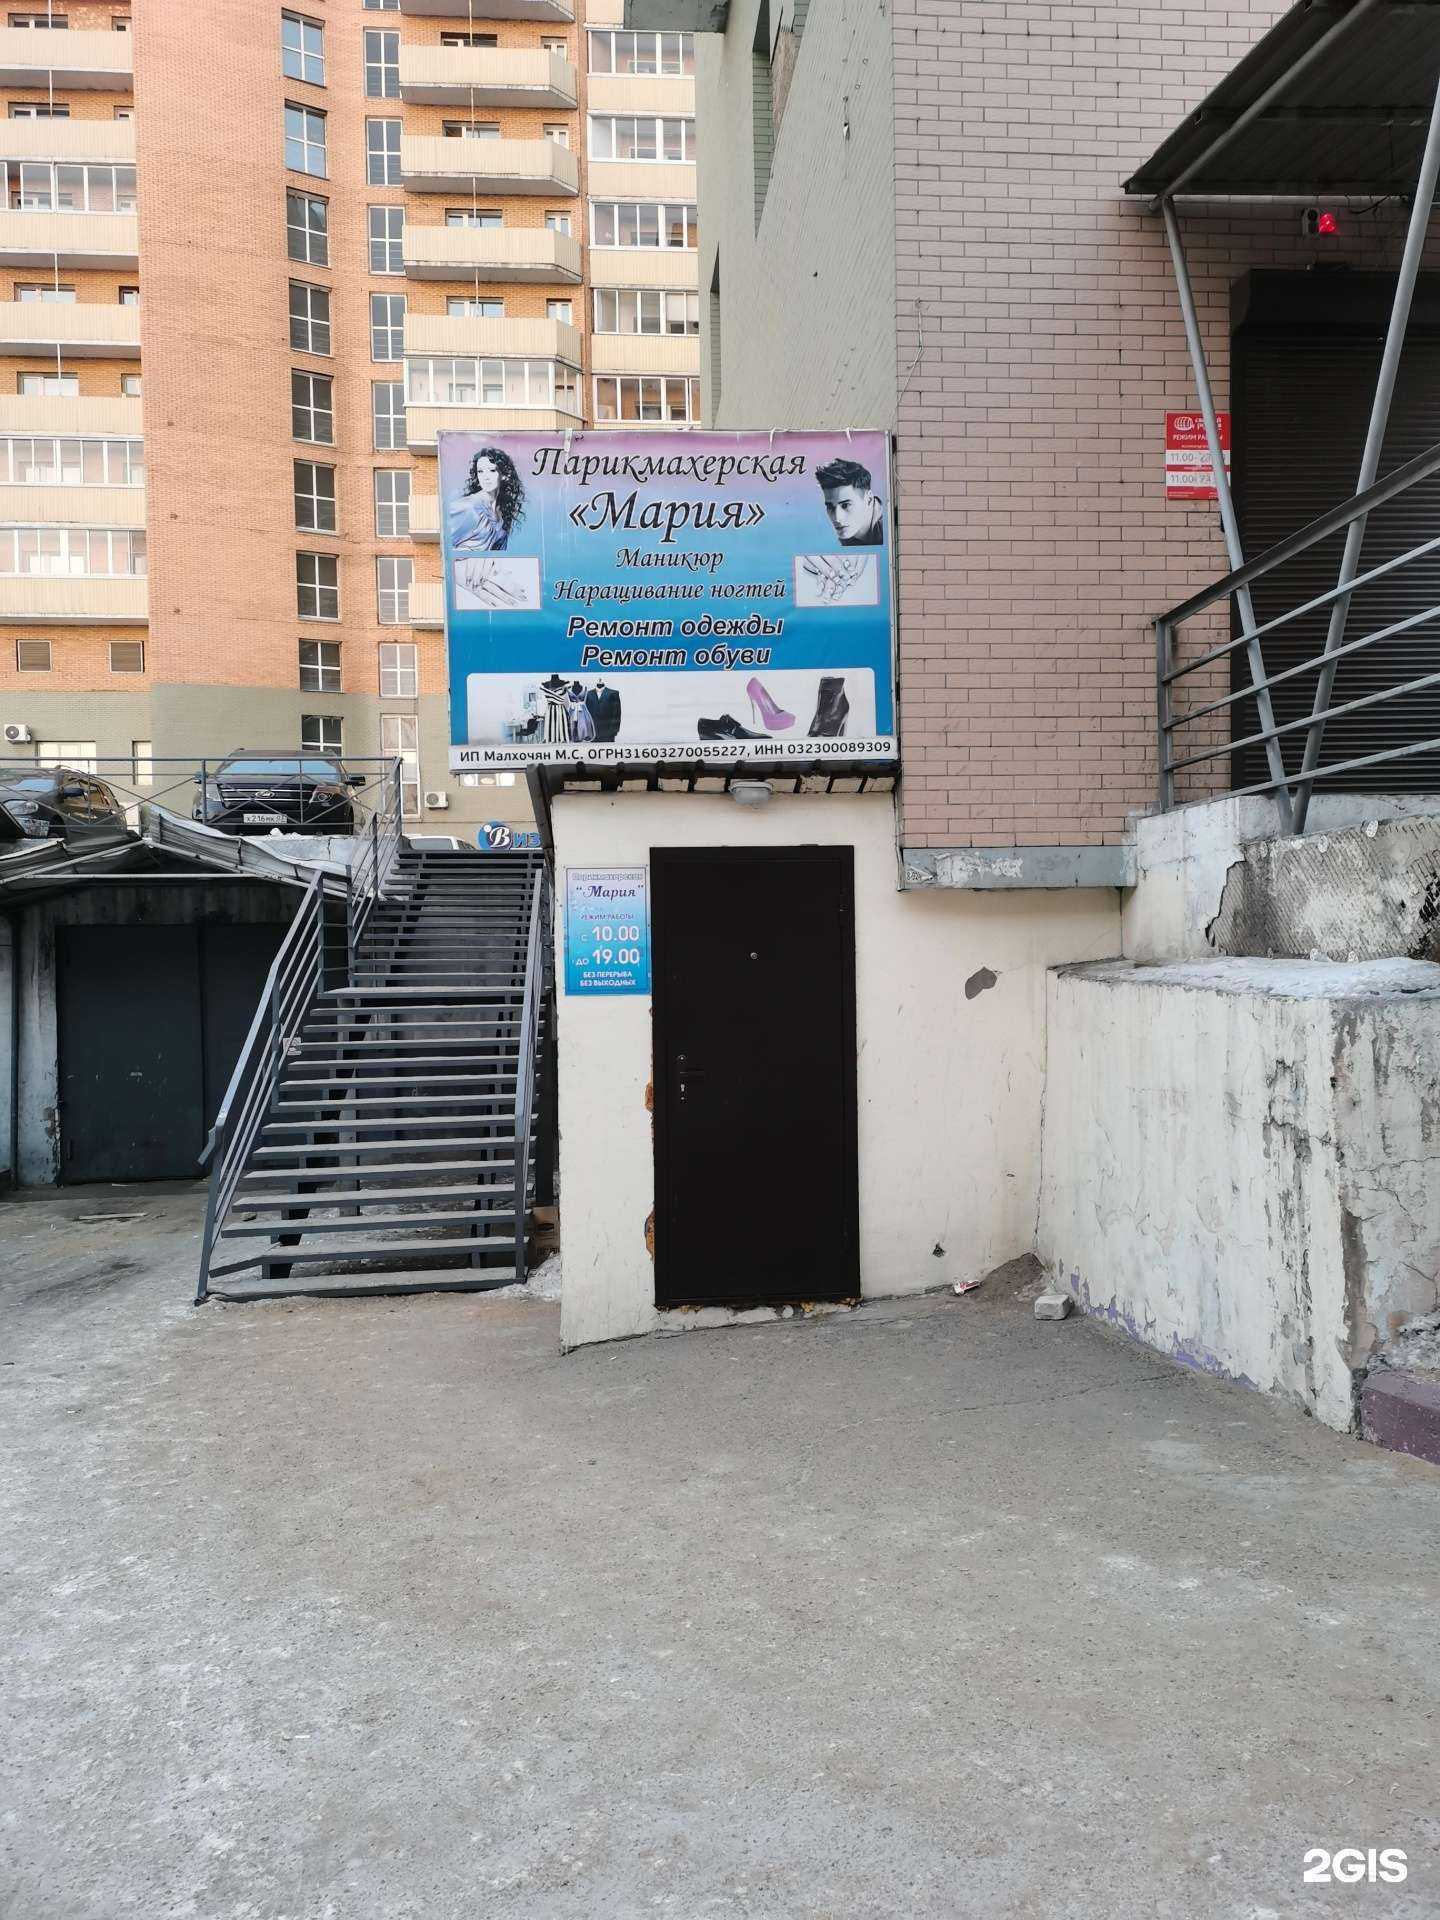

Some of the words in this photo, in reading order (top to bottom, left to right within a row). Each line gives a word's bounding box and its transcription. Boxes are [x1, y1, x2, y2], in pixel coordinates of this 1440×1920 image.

[531, 447, 807, 486] Парикмахерская
[569, 489, 766, 544] «Мария»
[616, 547, 725, 573] Маникюр
[553, 579, 704, 607] Наращивание
[710, 579, 786, 599] ногтей
[567, 615, 673, 638] Ремонт
[681, 613, 784, 637] одежды
[581, 643, 687, 667] Ремонт
[694, 642, 772, 670] обуви
[460, 751, 480, 762] ИП
[484, 750, 551, 762] Малхочян
[555, 749, 584, 760] М.С.
[754, 743, 784, 756] ИНН
[787, 741, 891, 755] 032300089309
[592, 925, 640, 941] 10.00
[592, 948, 640, 965] 19.00
[580, 979, 593, 987] БЕЗ
